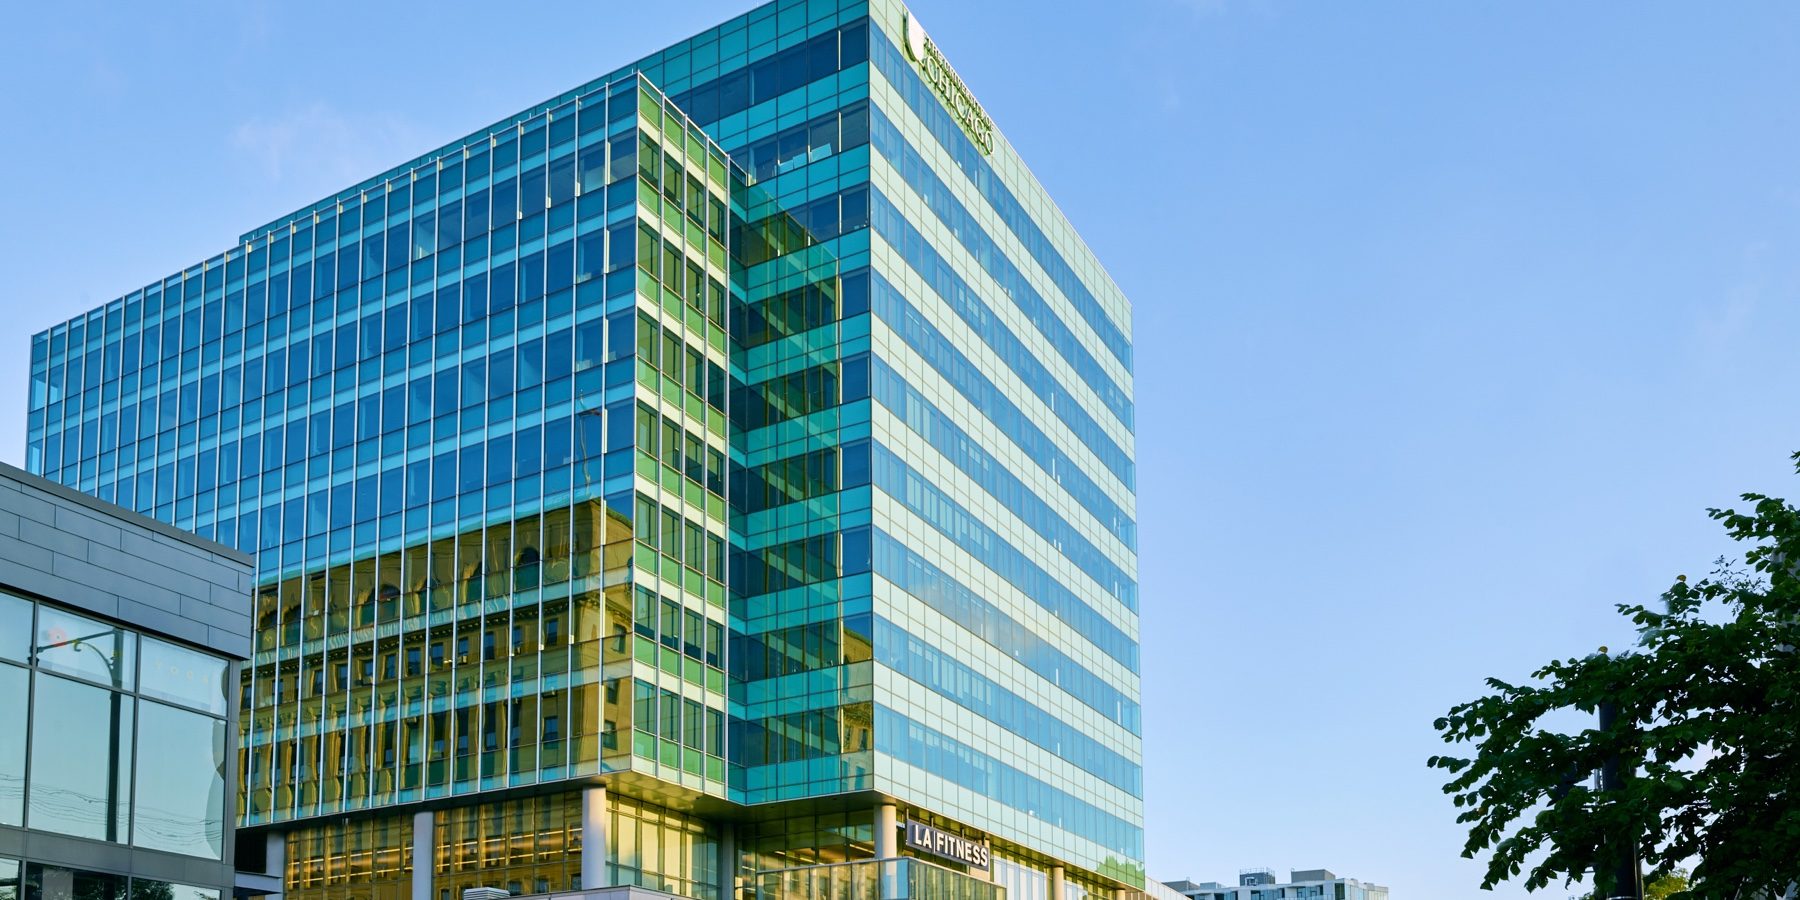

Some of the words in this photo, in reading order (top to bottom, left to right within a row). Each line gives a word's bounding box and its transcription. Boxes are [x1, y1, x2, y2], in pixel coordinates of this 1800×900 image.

[927, 55, 994, 154] CHICAGO
[915, 824, 933, 849] LA
[936, 832, 988, 867] FITNESS
